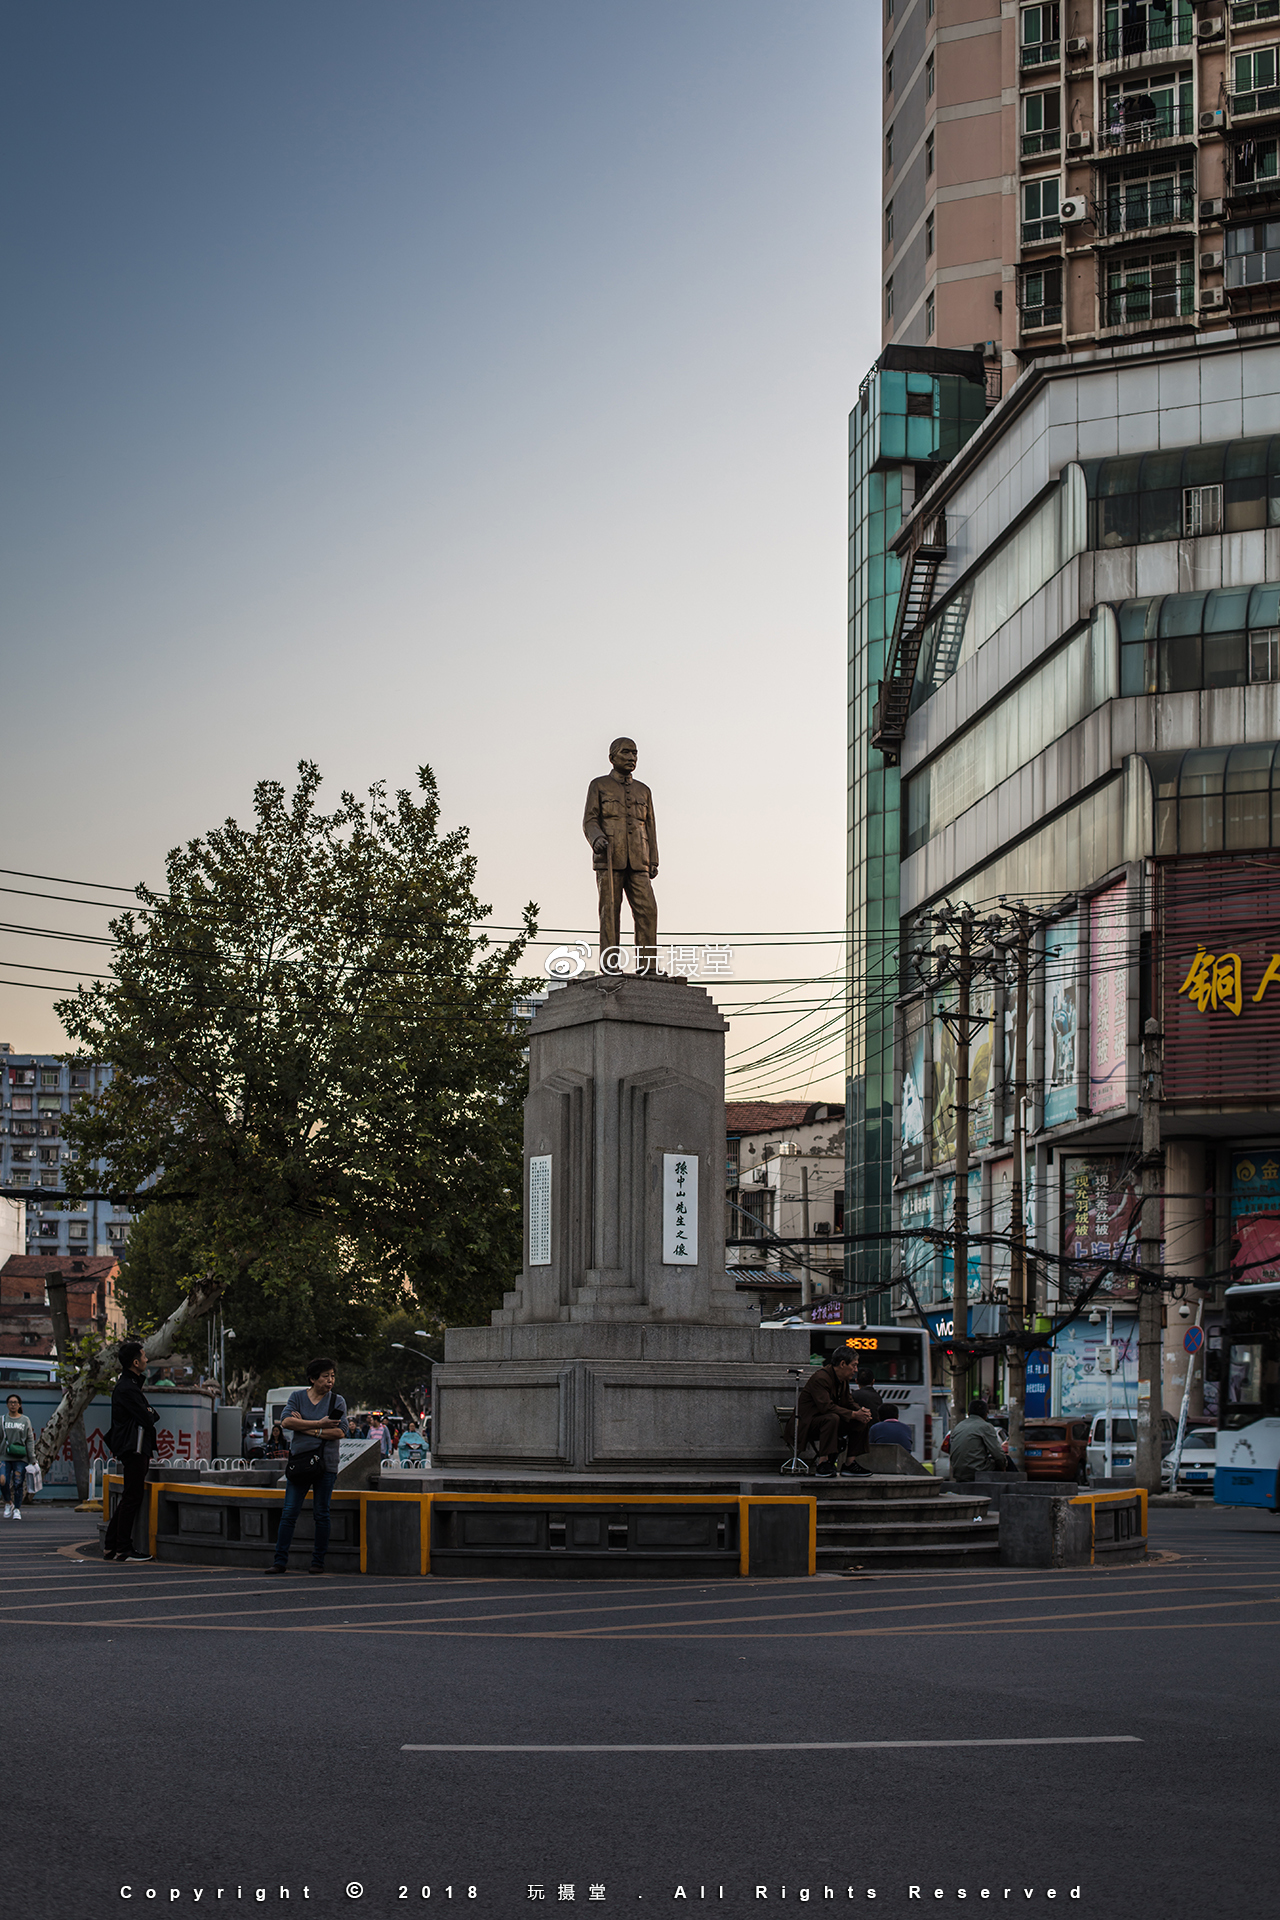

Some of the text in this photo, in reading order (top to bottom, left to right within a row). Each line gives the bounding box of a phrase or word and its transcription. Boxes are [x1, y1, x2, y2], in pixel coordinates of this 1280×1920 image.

[1075, 1175, 1089, 1237] 现充羽绒被
[935, 1317, 955, 1337] vivo
